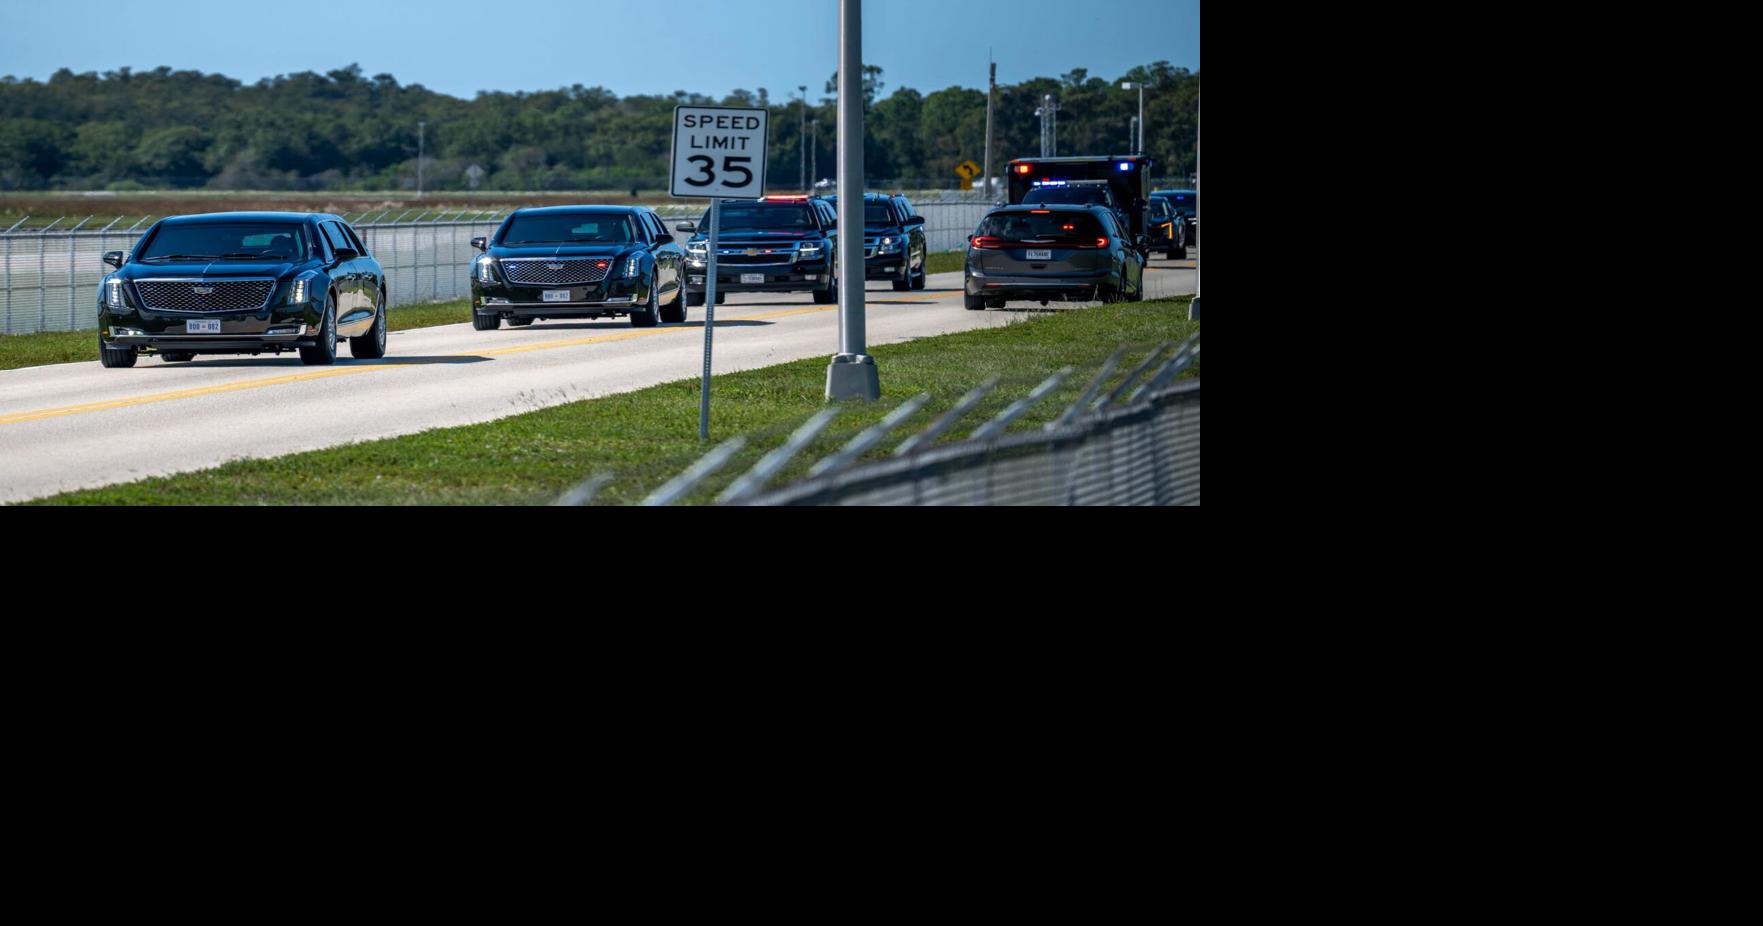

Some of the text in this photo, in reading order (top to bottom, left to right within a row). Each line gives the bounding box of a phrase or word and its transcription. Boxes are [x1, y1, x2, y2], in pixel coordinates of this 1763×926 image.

[683, 114, 760, 130] SPEED
[690, 135, 751, 150] LIMIT
[683, 154, 753, 188] 35
